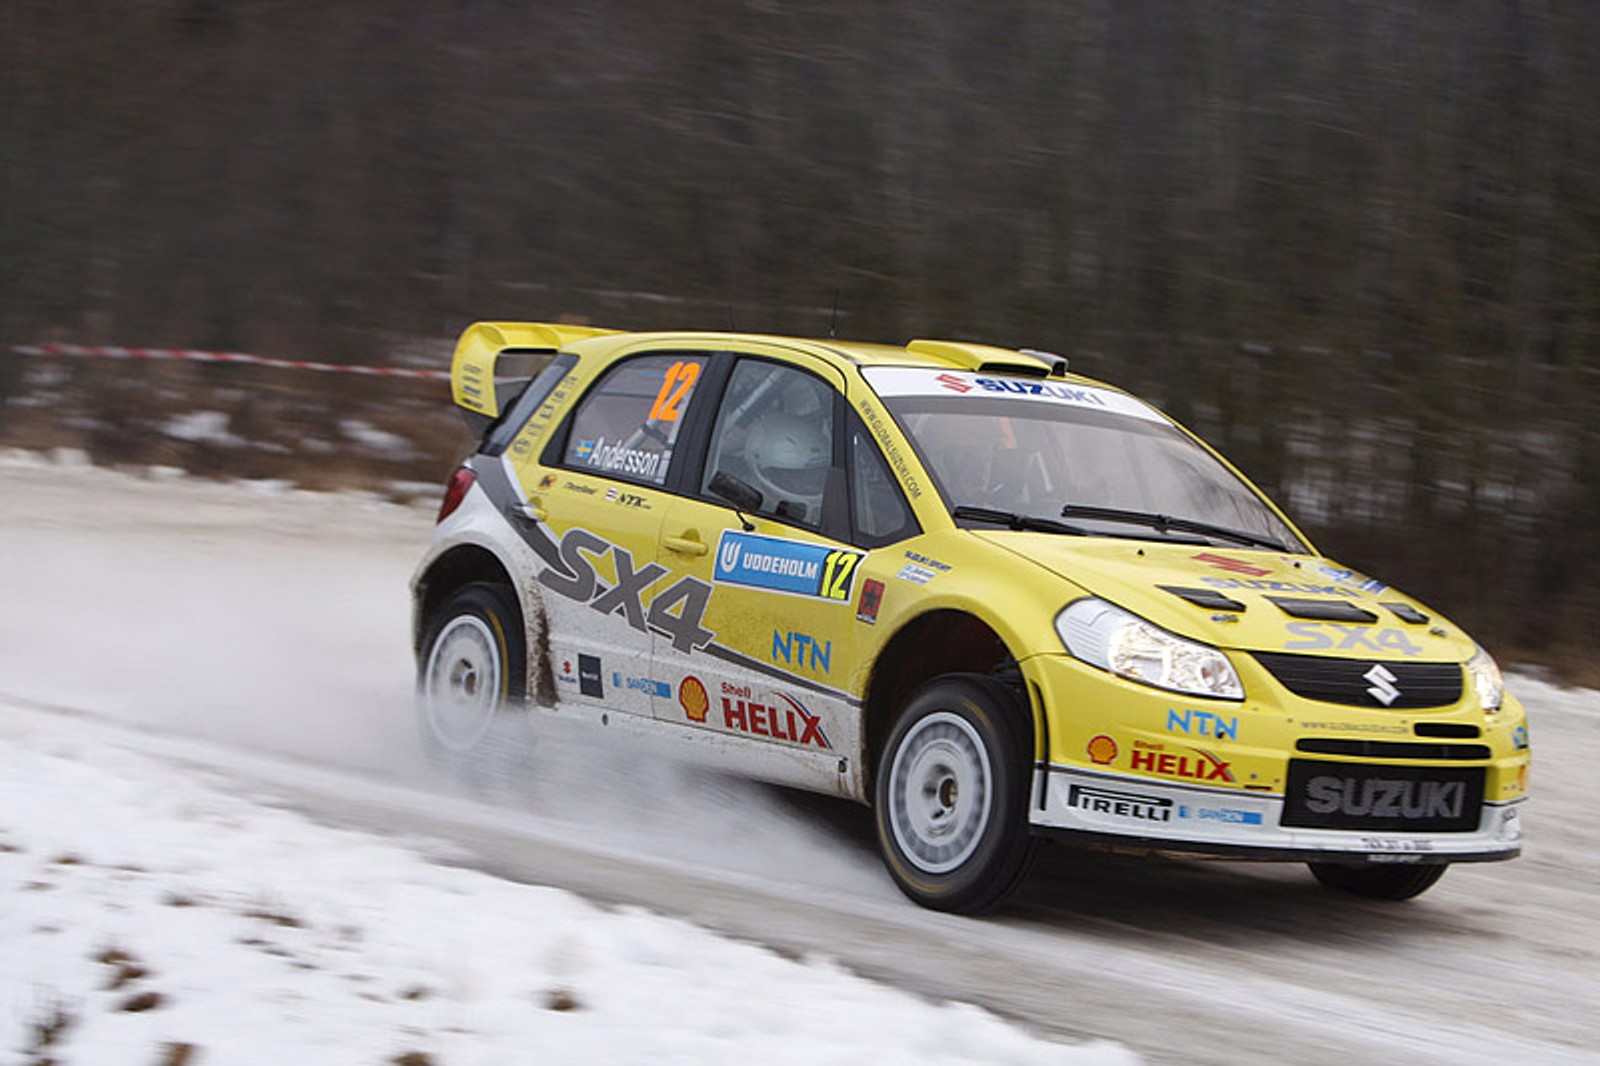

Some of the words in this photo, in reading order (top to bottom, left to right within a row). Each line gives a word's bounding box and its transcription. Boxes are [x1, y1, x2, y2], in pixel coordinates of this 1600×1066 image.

[648, 361, 701, 421] 12
[975, 378, 1105, 404] SUZUKI
[587, 436, 659, 476] Andersson
[539, 529, 716, 654] SX4
[820, 550, 858, 600] 12
[1200, 577, 1361, 598] SUZUKI
[772, 630, 831, 673] NTN
[1284, 622, 1423, 656] SX4
[721, 682, 751, 699] Shell
[721, 697, 829, 748] HELIX
[1167, 709, 1238, 741] NTN
[1131, 750, 1231, 782] HELIX
[1068, 784, 1174, 822] PIRELLI
[1305, 775, 1467, 819] SUZUKI
